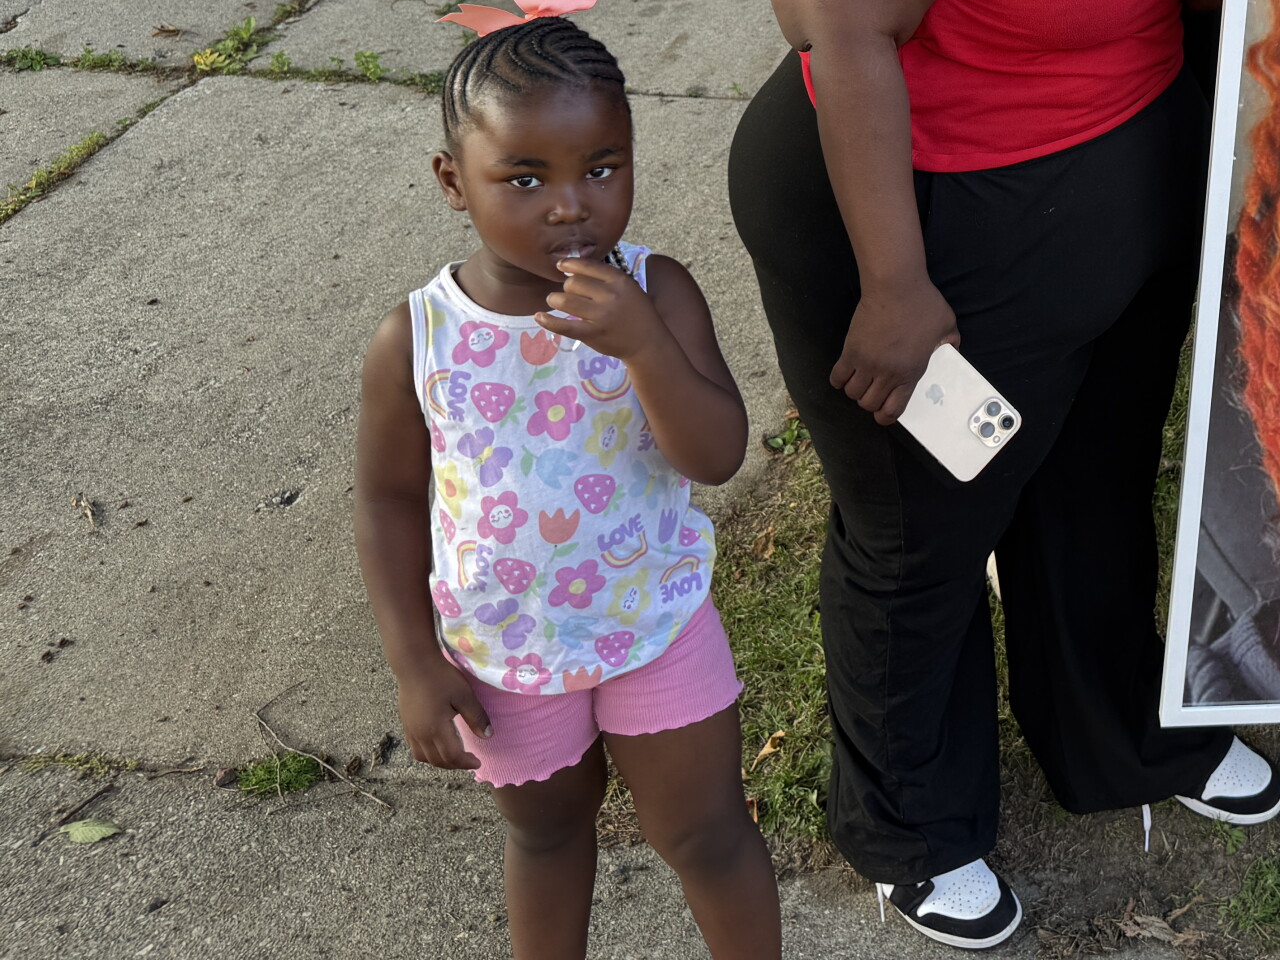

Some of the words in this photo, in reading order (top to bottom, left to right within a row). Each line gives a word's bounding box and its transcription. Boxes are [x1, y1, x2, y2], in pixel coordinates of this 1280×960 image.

[578, 355, 621, 380] LOV
[447, 370, 472, 423] LOVE
[597, 513, 645, 552] LOVE
[659, 572, 703, 604] LOVE
